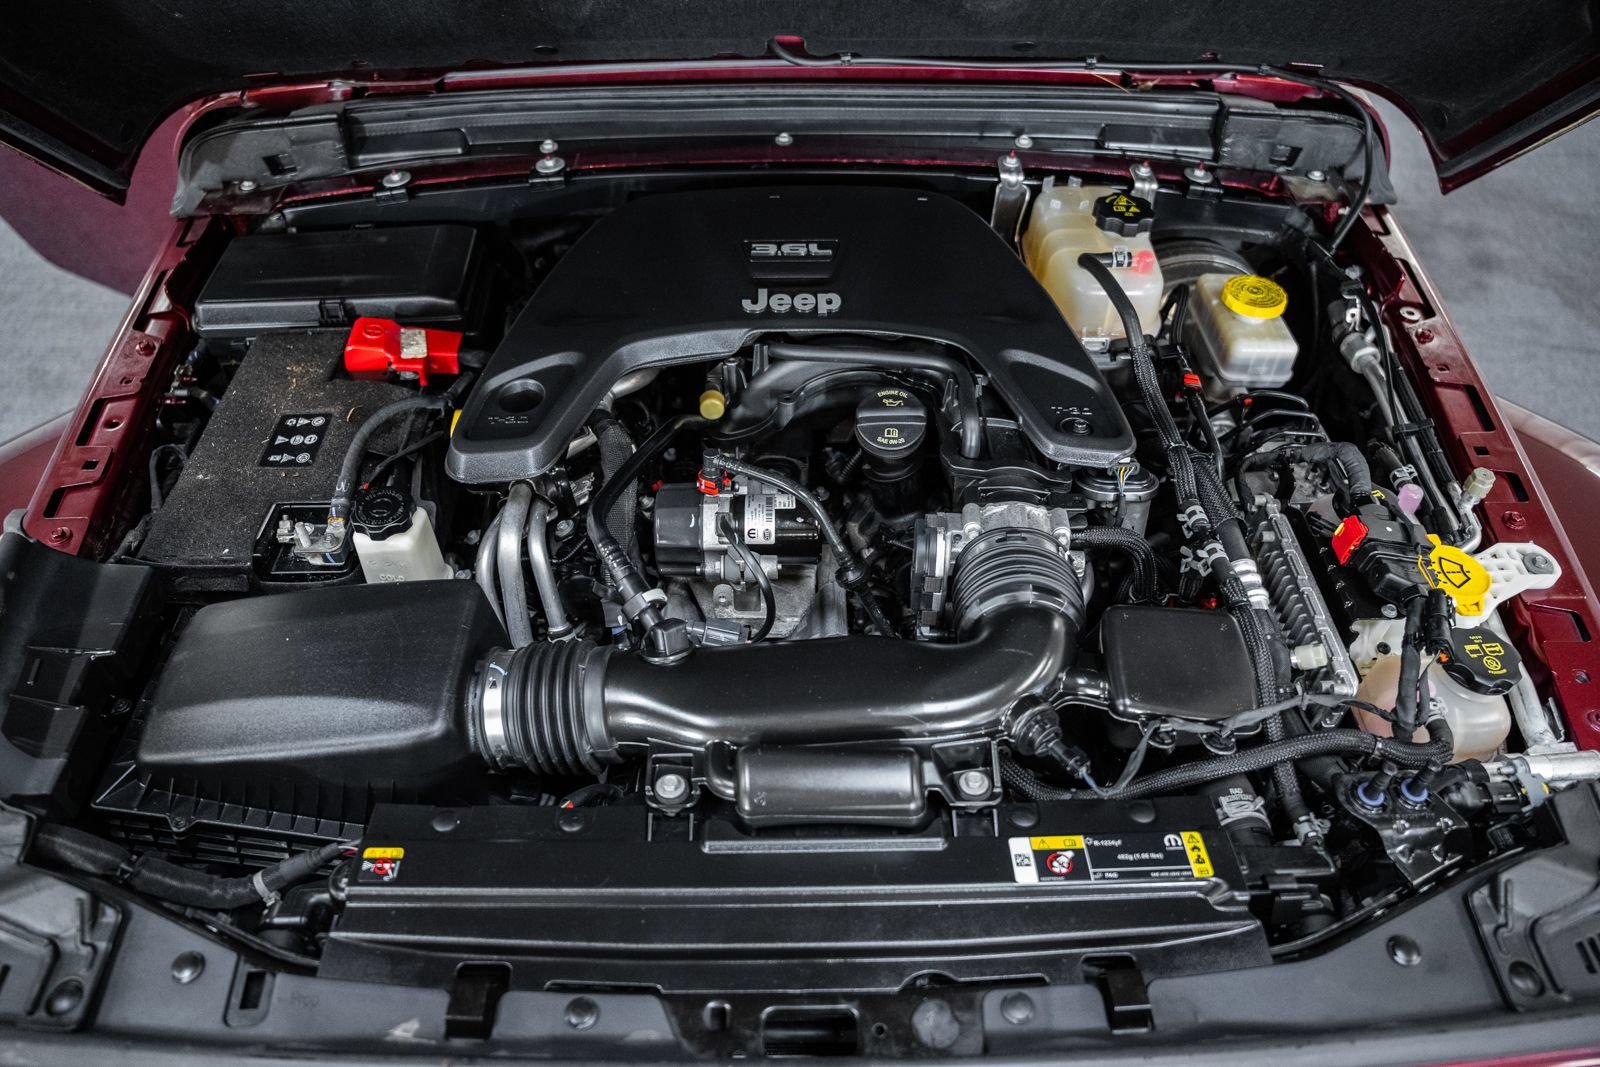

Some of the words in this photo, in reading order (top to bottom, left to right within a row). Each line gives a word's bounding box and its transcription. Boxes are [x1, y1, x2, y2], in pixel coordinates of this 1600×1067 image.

[750, 243, 833, 257] 3.6L
[741, 288, 842, 317] Jeep
[877, 390, 899, 398] ENGINE
[899, 391, 908, 399] OIL
[877, 436, 889, 444] SAE
[889, 437, 905, 445] 0W-20
[379, 574, 405, 582] COLD
